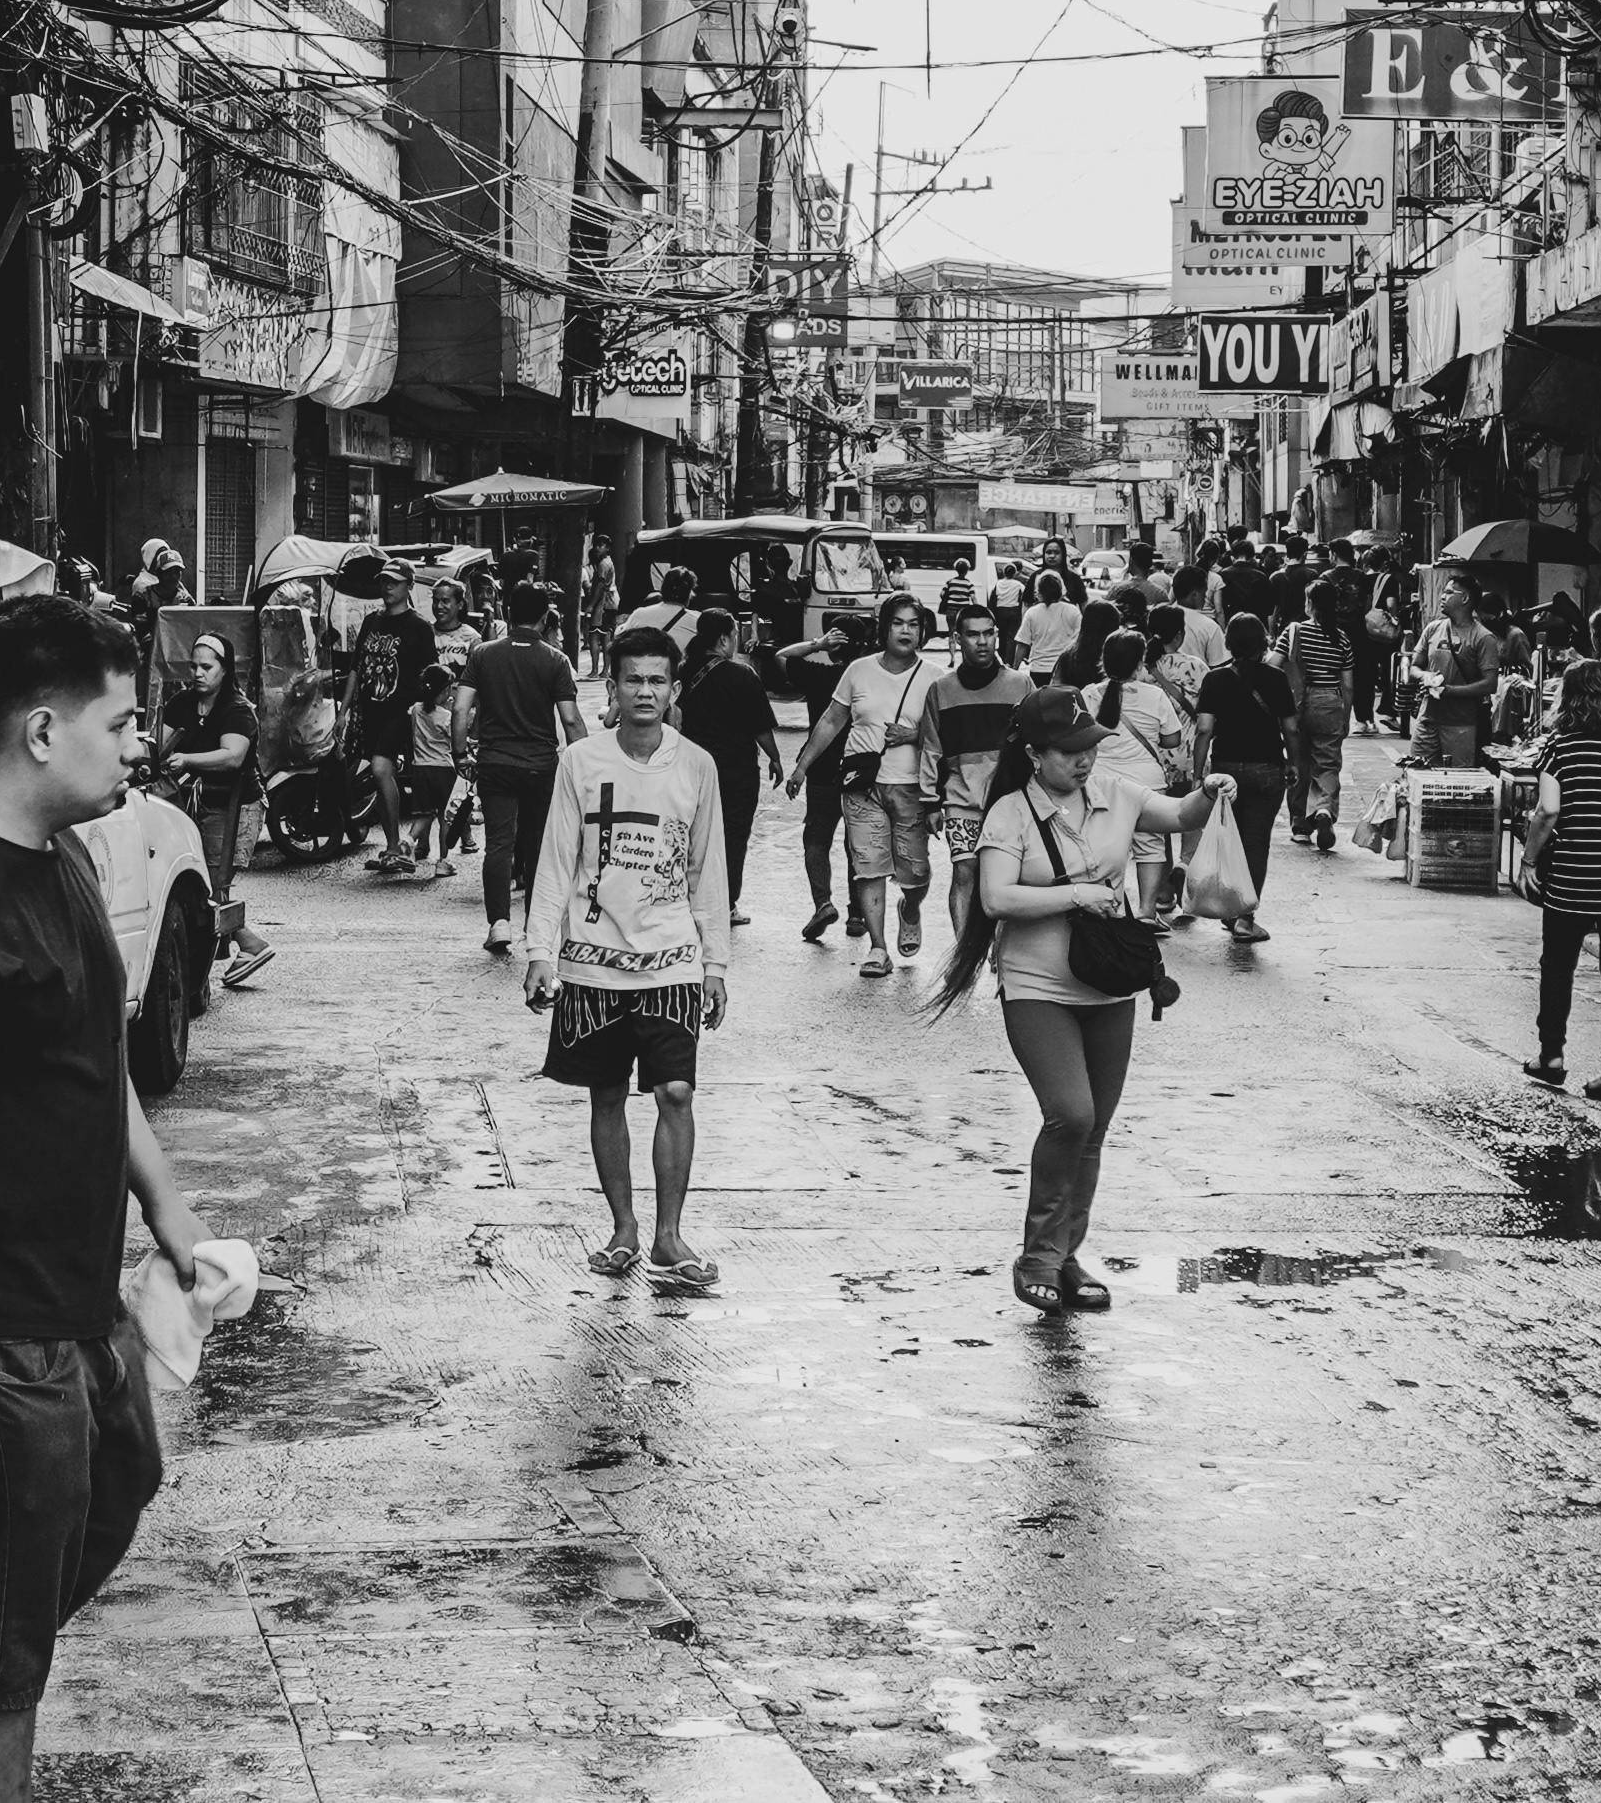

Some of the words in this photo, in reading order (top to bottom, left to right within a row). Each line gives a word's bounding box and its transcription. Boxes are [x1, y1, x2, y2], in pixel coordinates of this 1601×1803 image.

[1361, 28, 1426, 99] E
[1213, 177, 1384, 210] EYE-ZIAH
[1234, 212, 1299, 224] OPTICAL
[1305, 212, 1357, 224] CLINIC
[1209, 248, 1272, 260] OPTICAL
[1276, 247, 1327, 259] CLINIC
[1201, 323, 1281, 384] YOU
[901, 371, 972, 391] VILLARICA
[1176, 403, 1210, 412] ITEMS
[633, 831, 656, 844] Ave
[560, 941, 616, 966] SABAY
[616, 952, 644, 971] SA
[644, 945, 697, 971] AGOS
